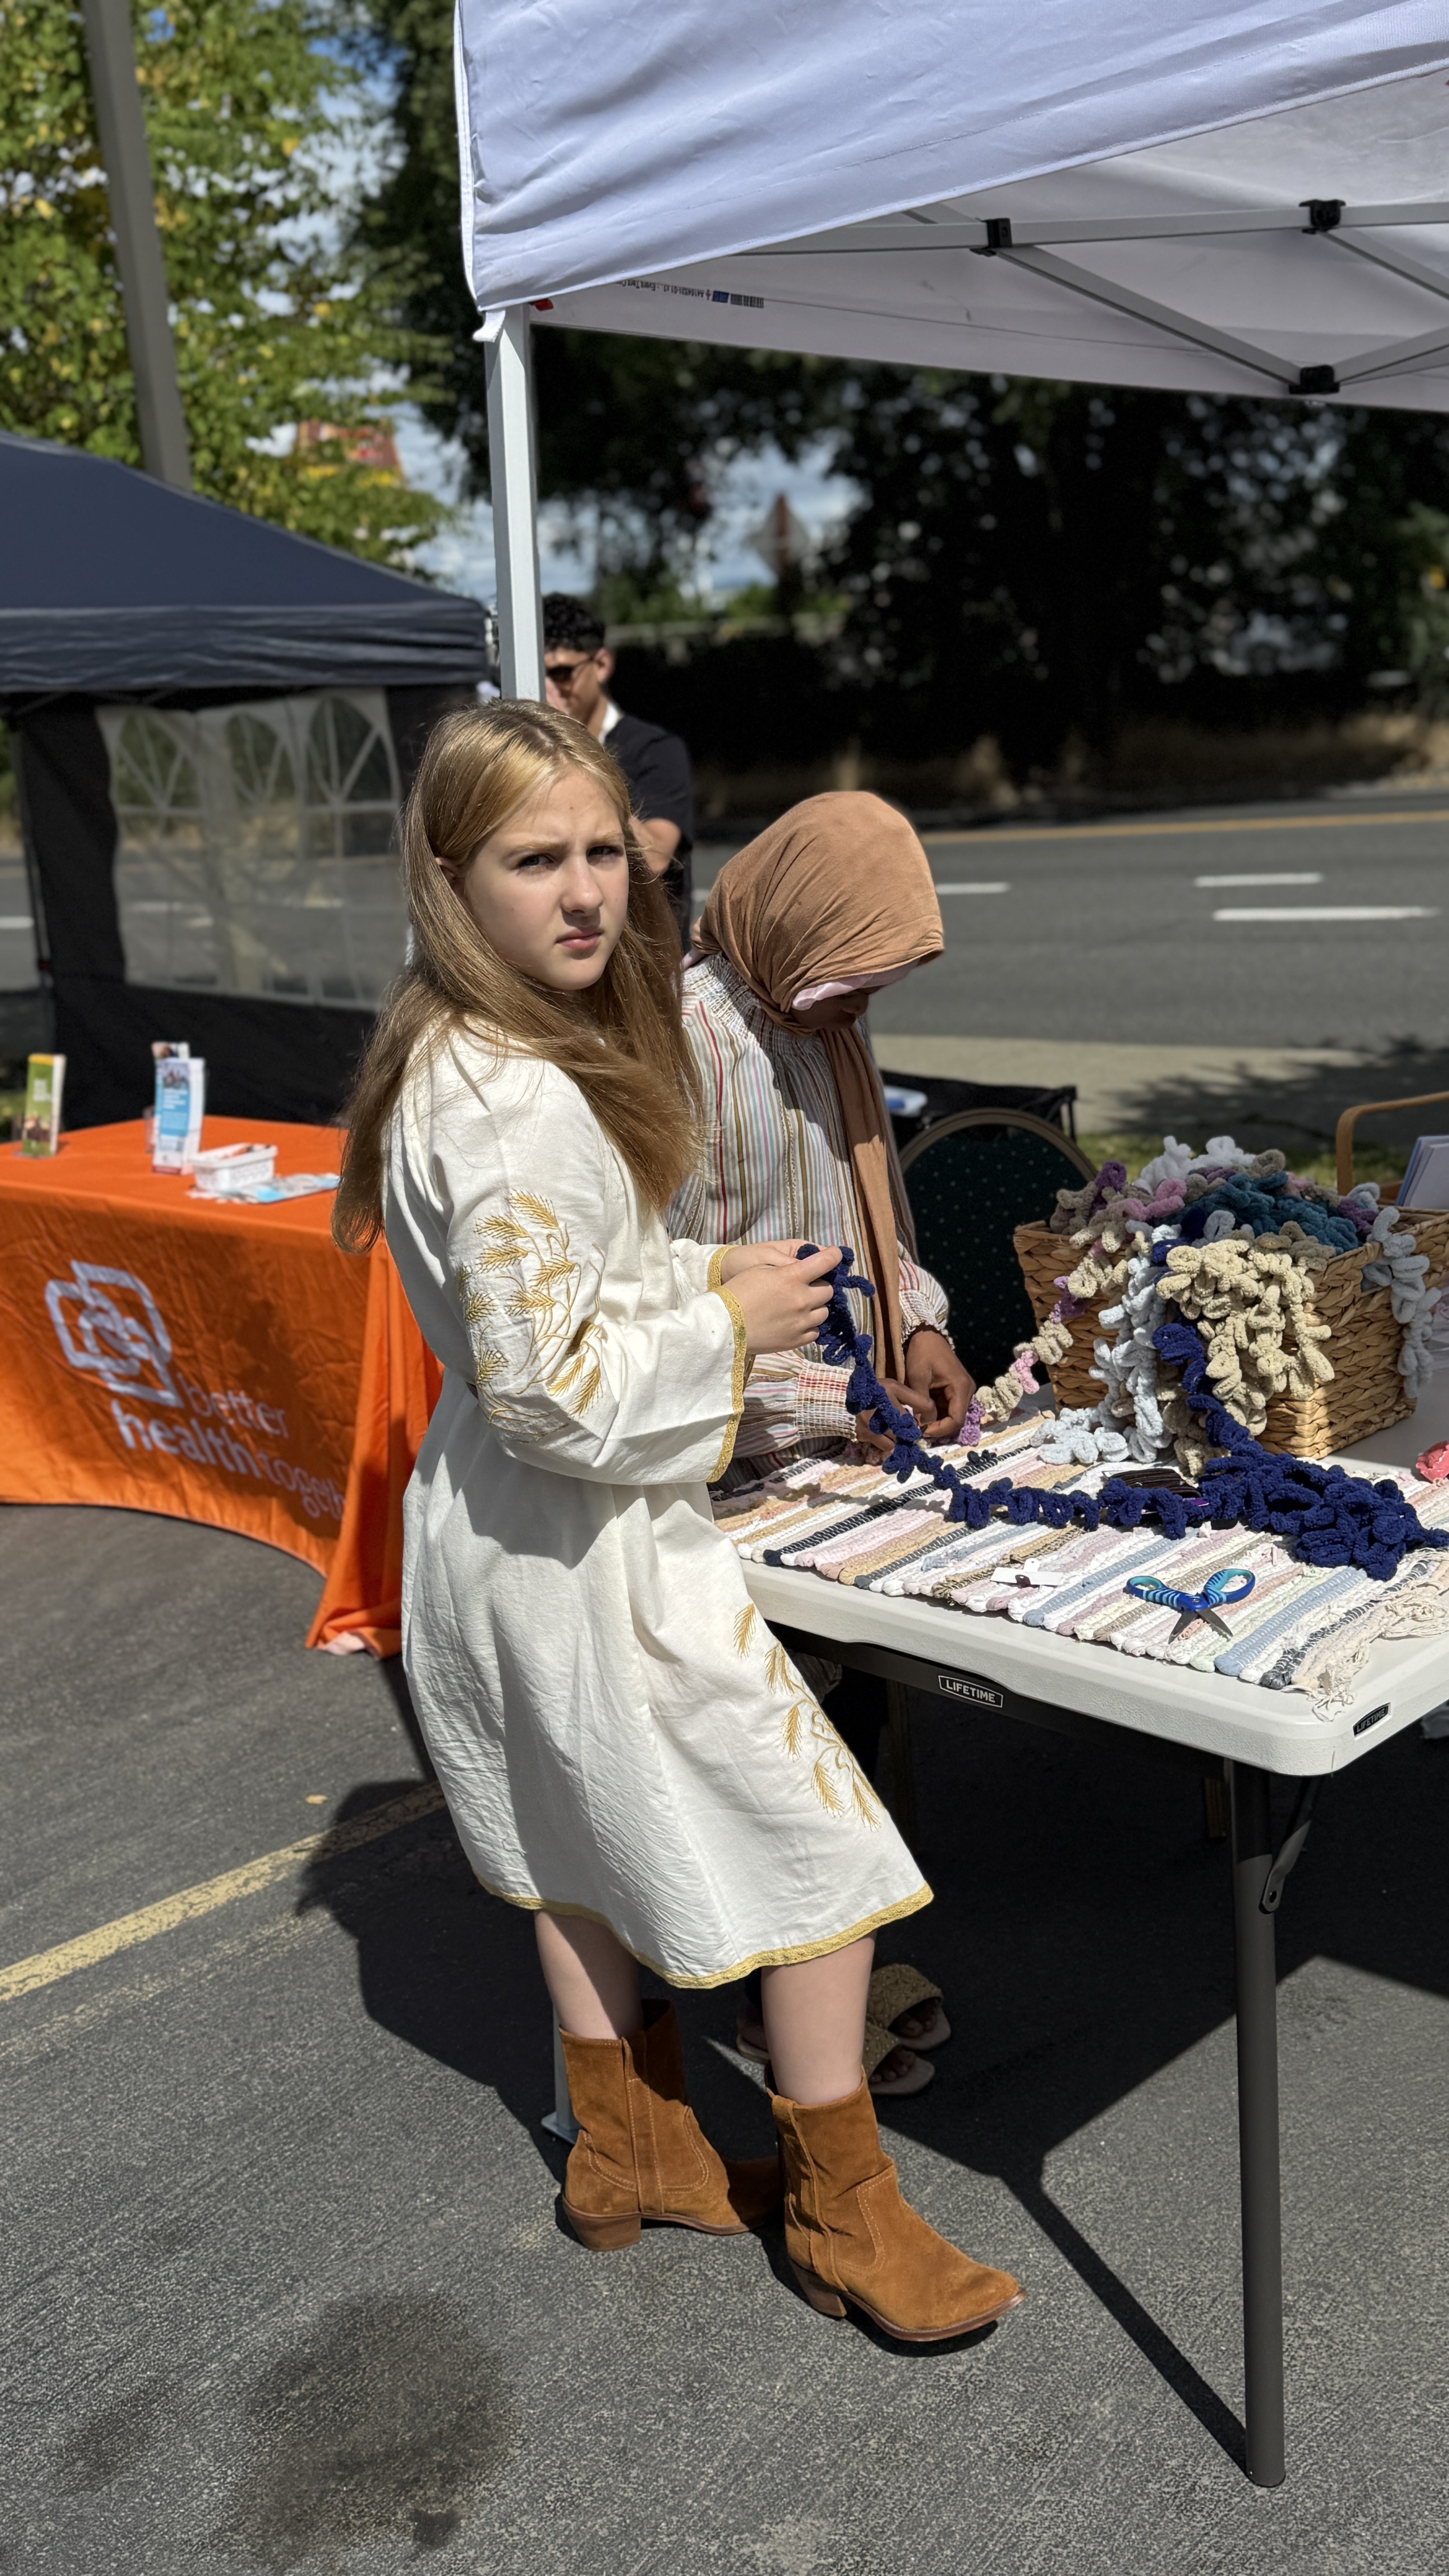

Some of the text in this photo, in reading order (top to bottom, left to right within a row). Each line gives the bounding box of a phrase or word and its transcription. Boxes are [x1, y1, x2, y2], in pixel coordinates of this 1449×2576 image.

[177, 1372, 289, 1439] better
[111, 1399, 345, 1521] health togeth
[946, 1679, 996, 1703] LIFETIME
[1357, 1708, 1386, 1733] LIFETIME
